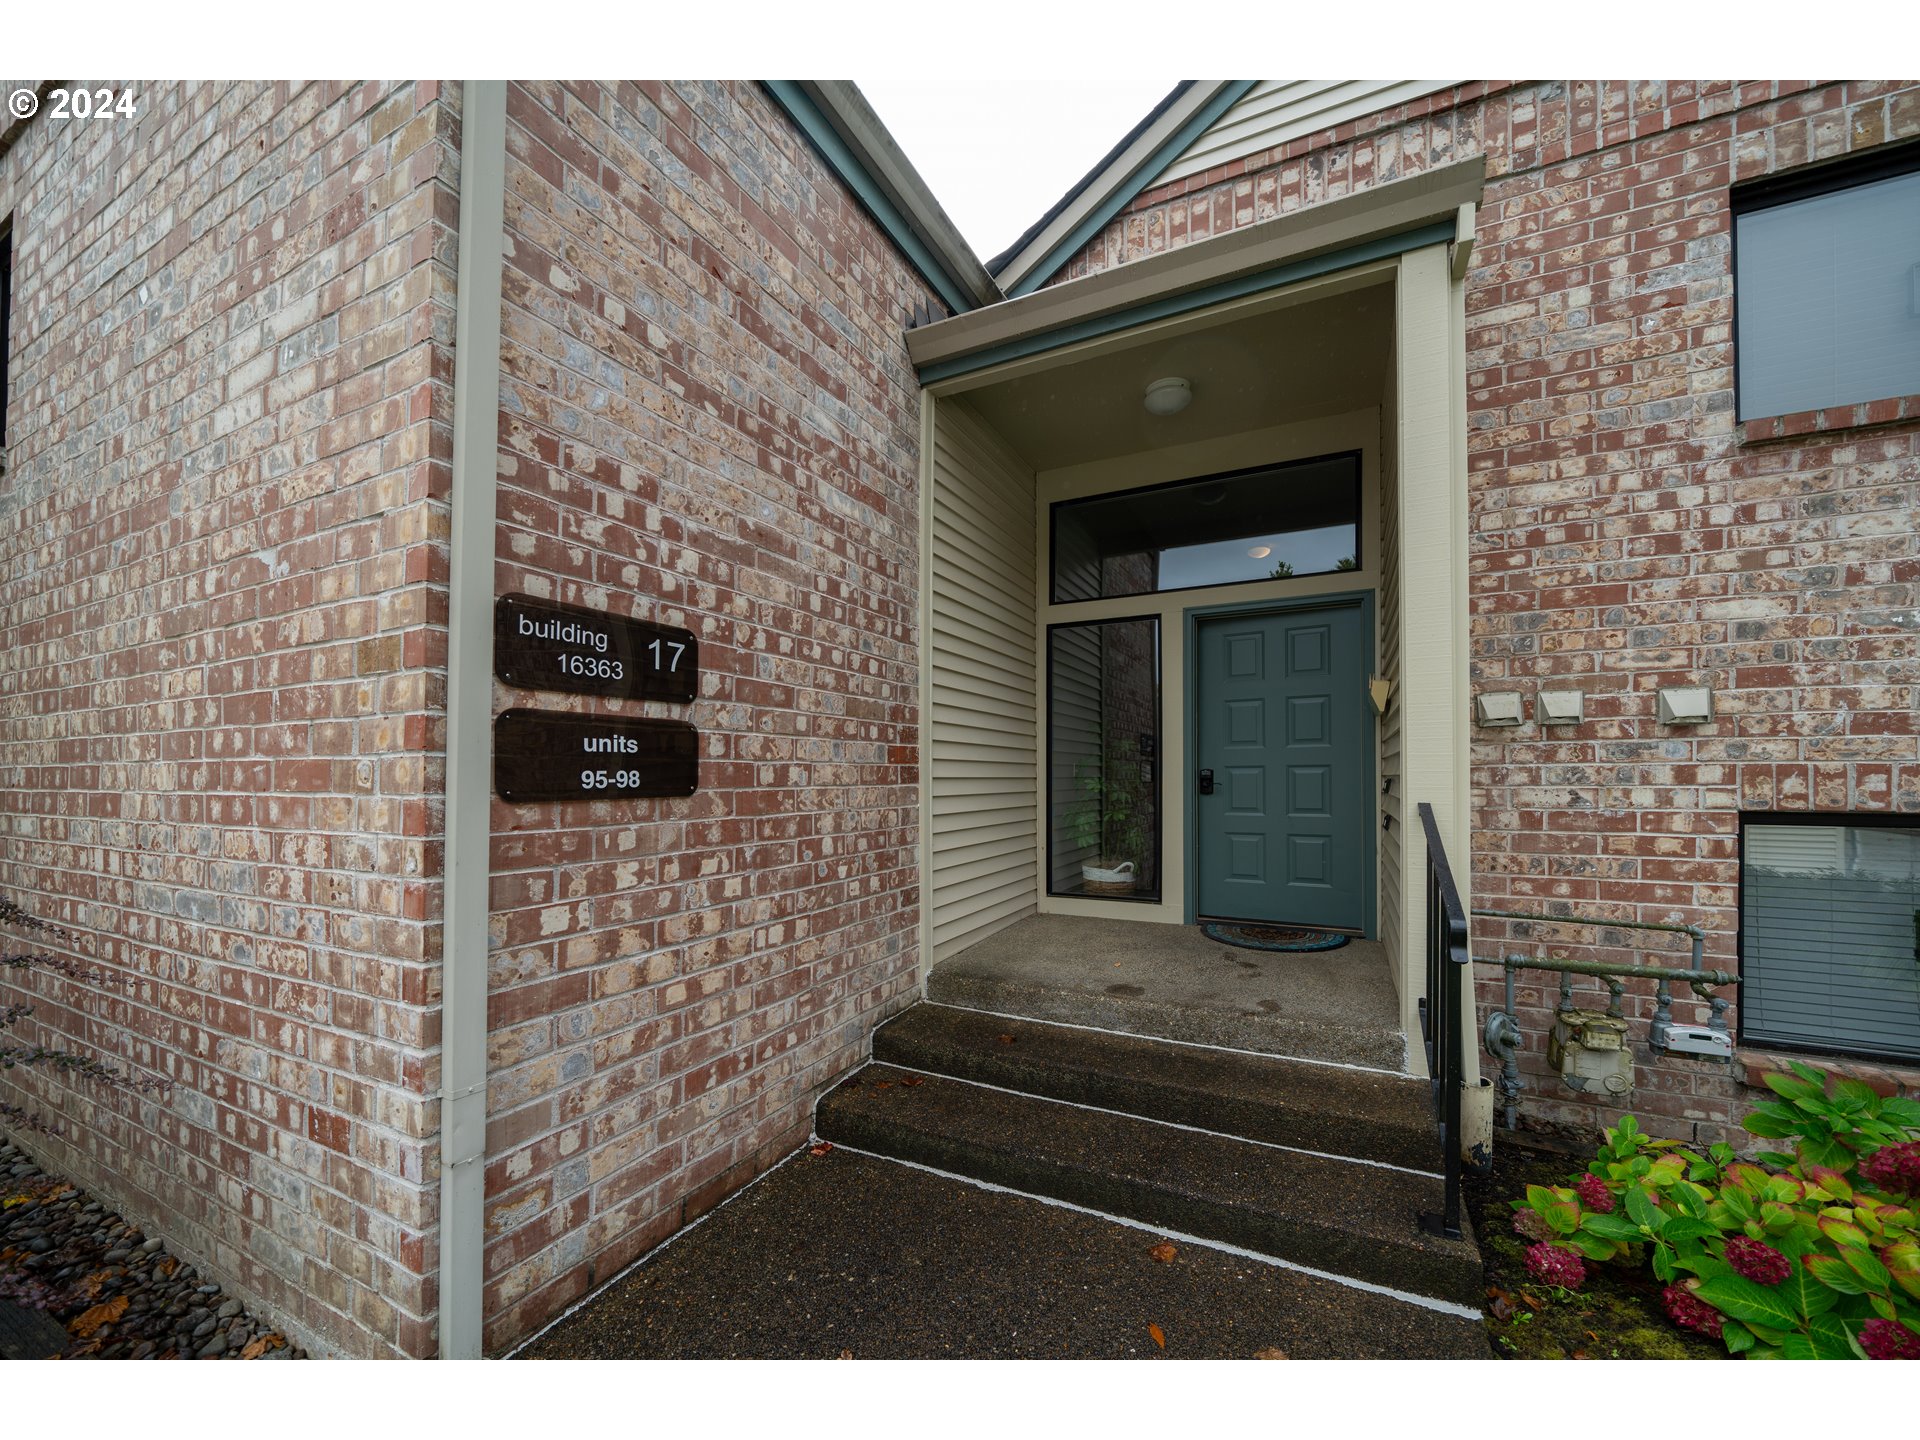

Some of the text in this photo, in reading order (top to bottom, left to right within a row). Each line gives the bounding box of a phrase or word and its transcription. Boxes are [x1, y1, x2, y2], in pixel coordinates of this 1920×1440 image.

[519, 613, 608, 652] building
[557, 653, 624, 680] 16363
[648, 638, 686, 673] 17
[583, 734, 639, 754] units
[581, 770, 641, 789] 95-98
